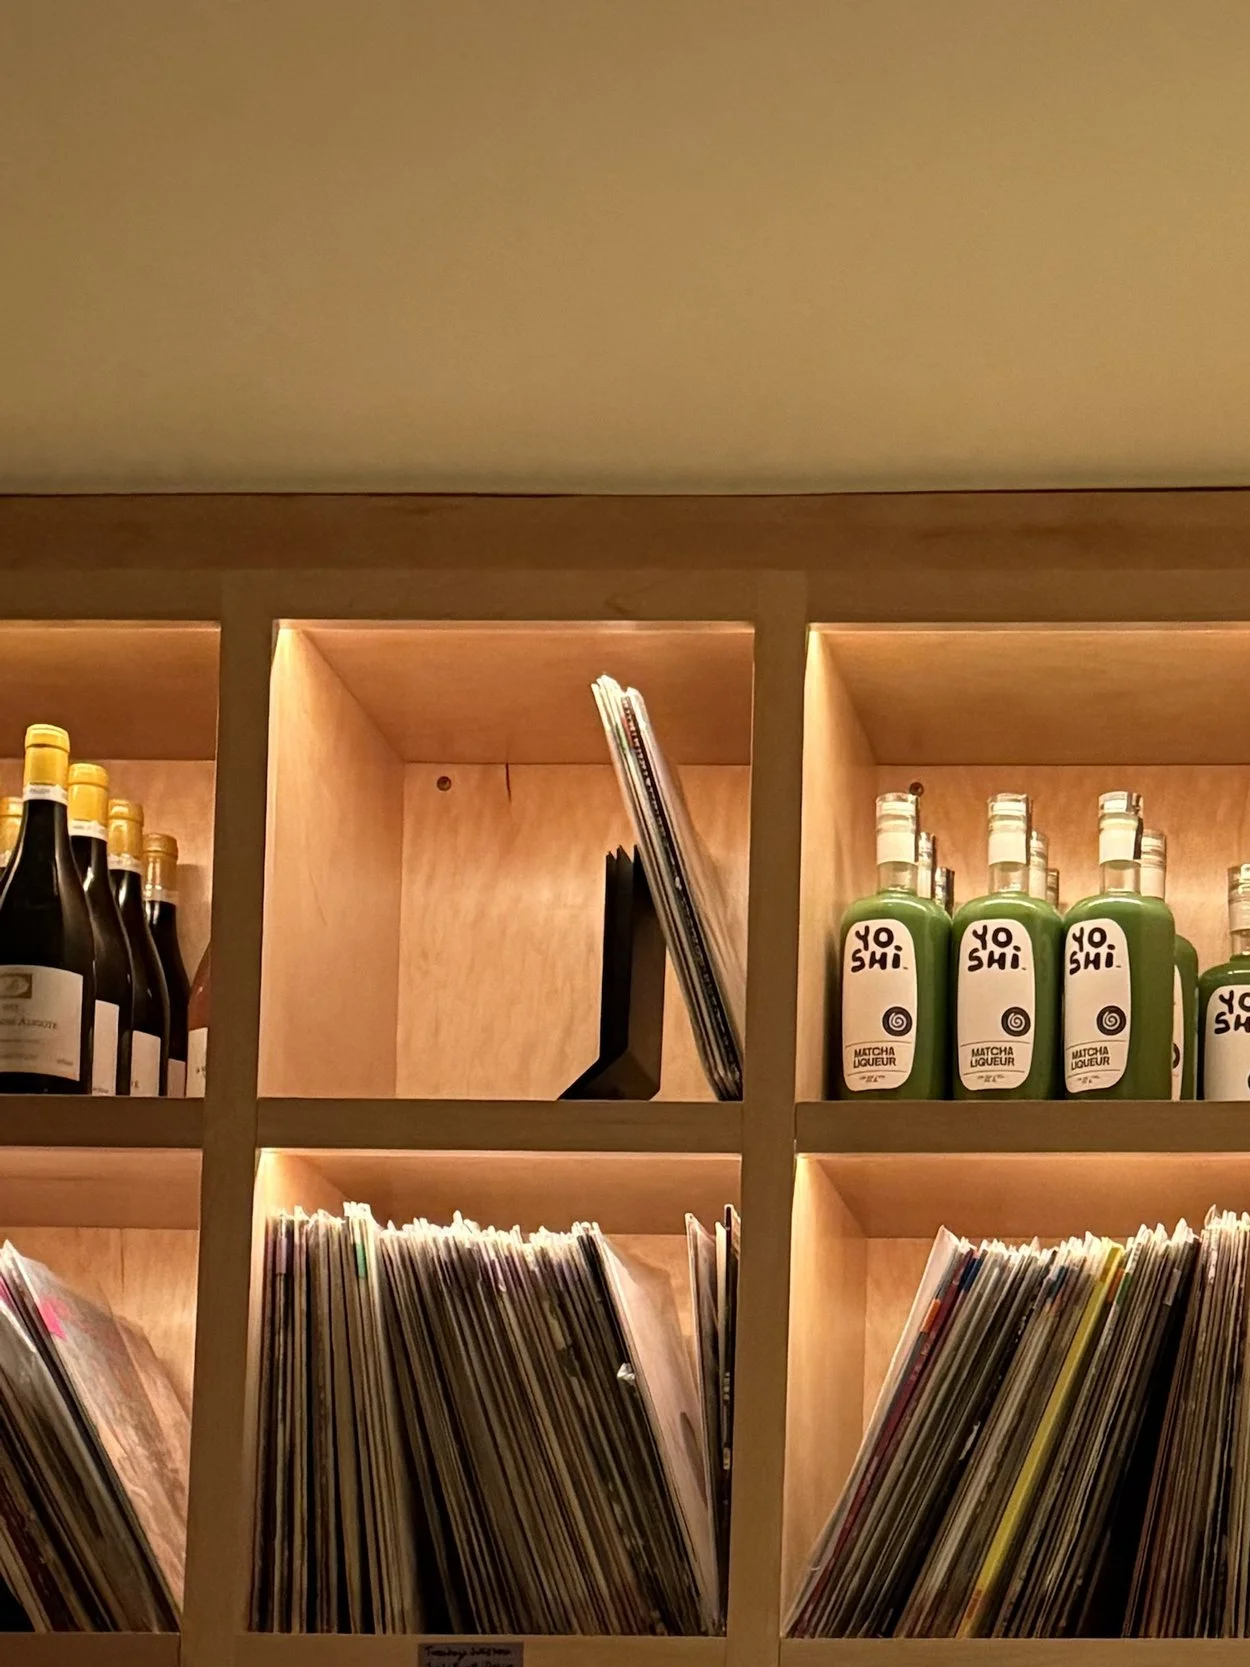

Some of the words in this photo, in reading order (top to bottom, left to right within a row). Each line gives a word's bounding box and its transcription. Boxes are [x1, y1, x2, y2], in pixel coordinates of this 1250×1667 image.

[855, 925, 894, 951] YO
[972, 925, 1013, 950] YO
[1072, 926, 1107, 952] YO
[854, 1047, 895, 1058] MATCHA
[971, 1046, 1014, 1058] MATCHA
[1072, 1046, 1109, 1060] MATCHA
[853, 1057, 897, 1068] LIQUEUR
[970, 1056, 1015, 1068] LIQUEUR
[1071, 1056, 1110, 1070] LIQUEUR
